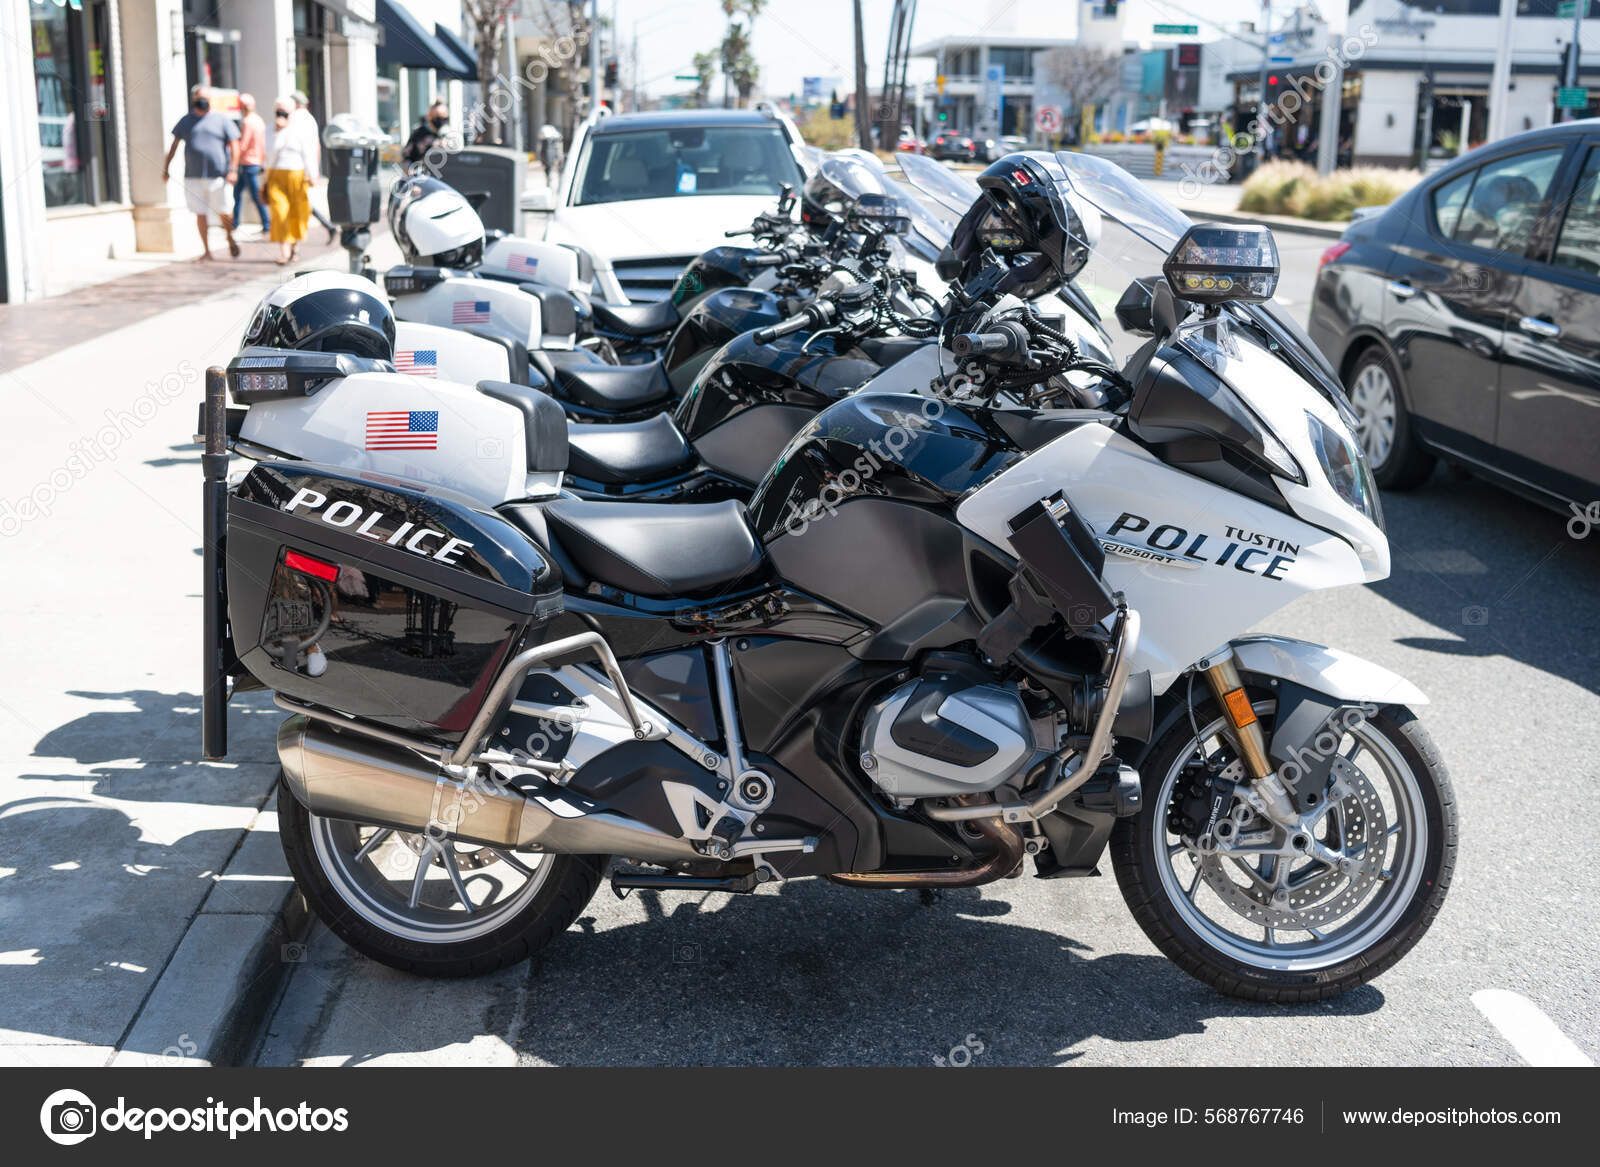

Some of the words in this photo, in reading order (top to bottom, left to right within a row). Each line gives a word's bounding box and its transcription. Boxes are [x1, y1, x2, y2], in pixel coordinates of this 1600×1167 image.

[285, 487, 475, 565] POLICE
[1106, 511, 1296, 581] POLICE
[1224, 525, 1301, 556] TUSTIN
